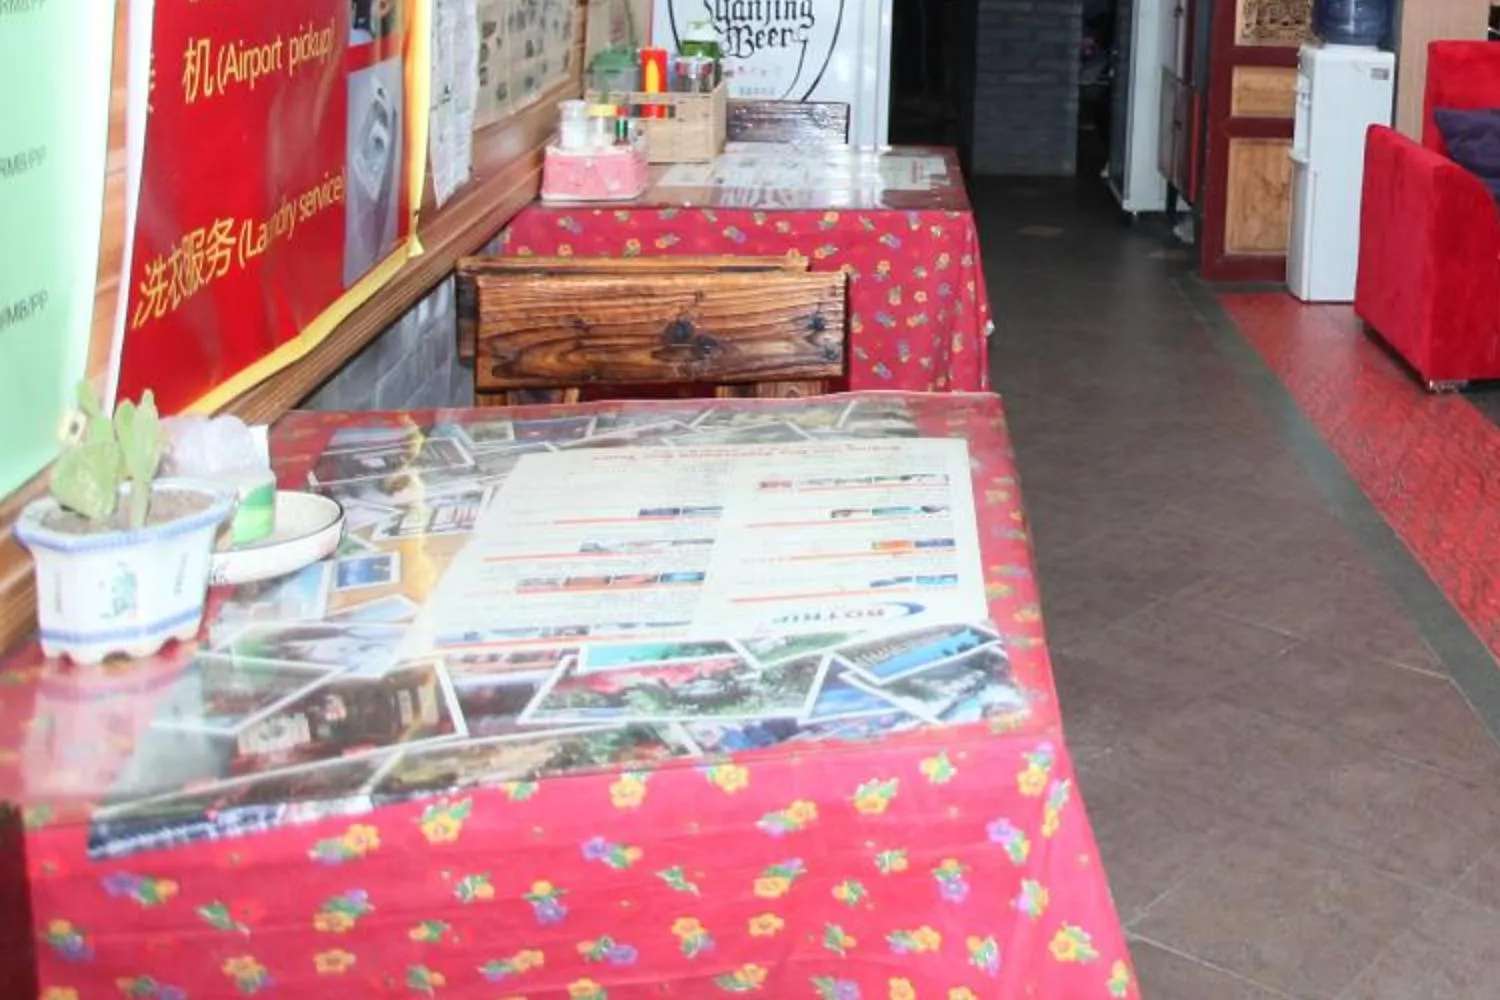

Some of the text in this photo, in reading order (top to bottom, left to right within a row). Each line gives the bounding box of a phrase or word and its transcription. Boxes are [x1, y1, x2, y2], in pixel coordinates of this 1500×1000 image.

[216, 33, 283, 96] (Airport
[727, 24, 796, 59] Beer
[131, 216, 236, 329] 洗衣服务
